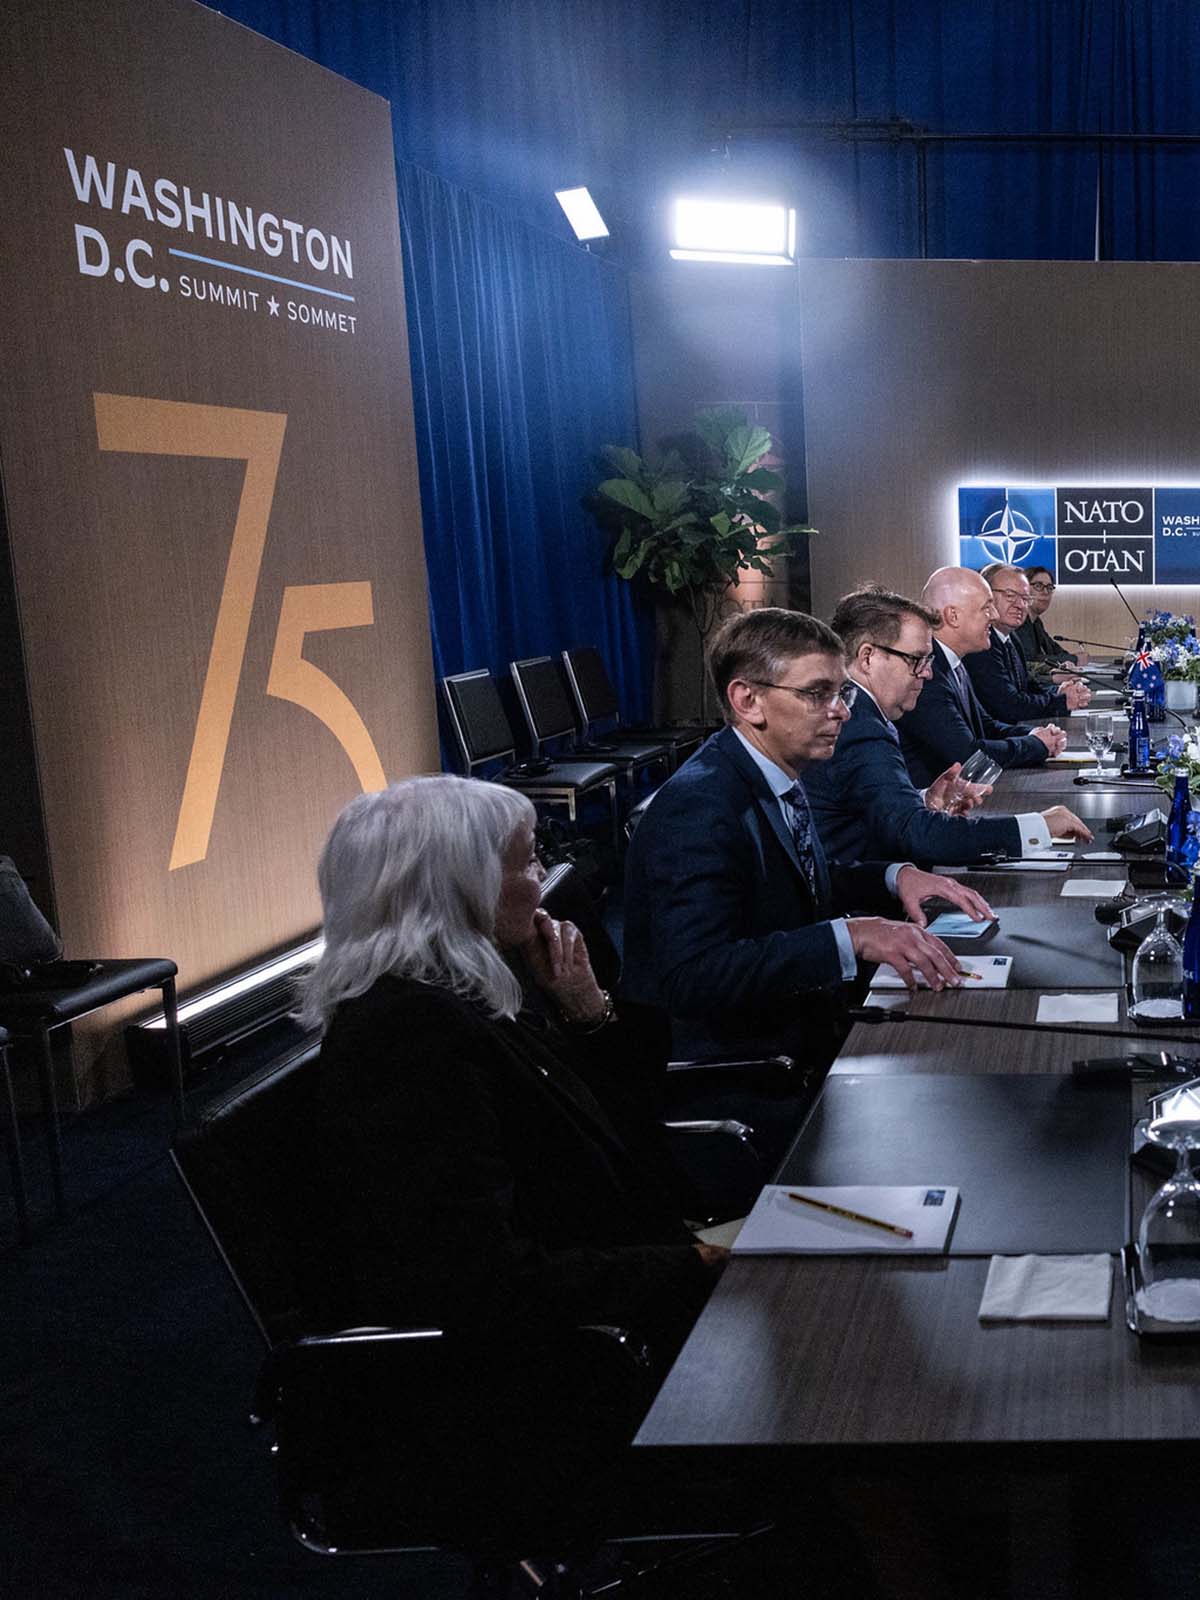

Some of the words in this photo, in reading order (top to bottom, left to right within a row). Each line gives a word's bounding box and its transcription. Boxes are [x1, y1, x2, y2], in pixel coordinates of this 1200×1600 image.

[64, 147, 354, 279] WASHINGTON
[74, 223, 170, 293] D.C.
[179, 275, 260, 313] SUMMIT
[287, 301, 357, 335] SOMMET
[1064, 500, 1145, 524] NATO
[1162, 527, 1187, 537] D.C.
[1064, 549, 1145, 573] OTAN
[93, 392, 389, 872] 75
